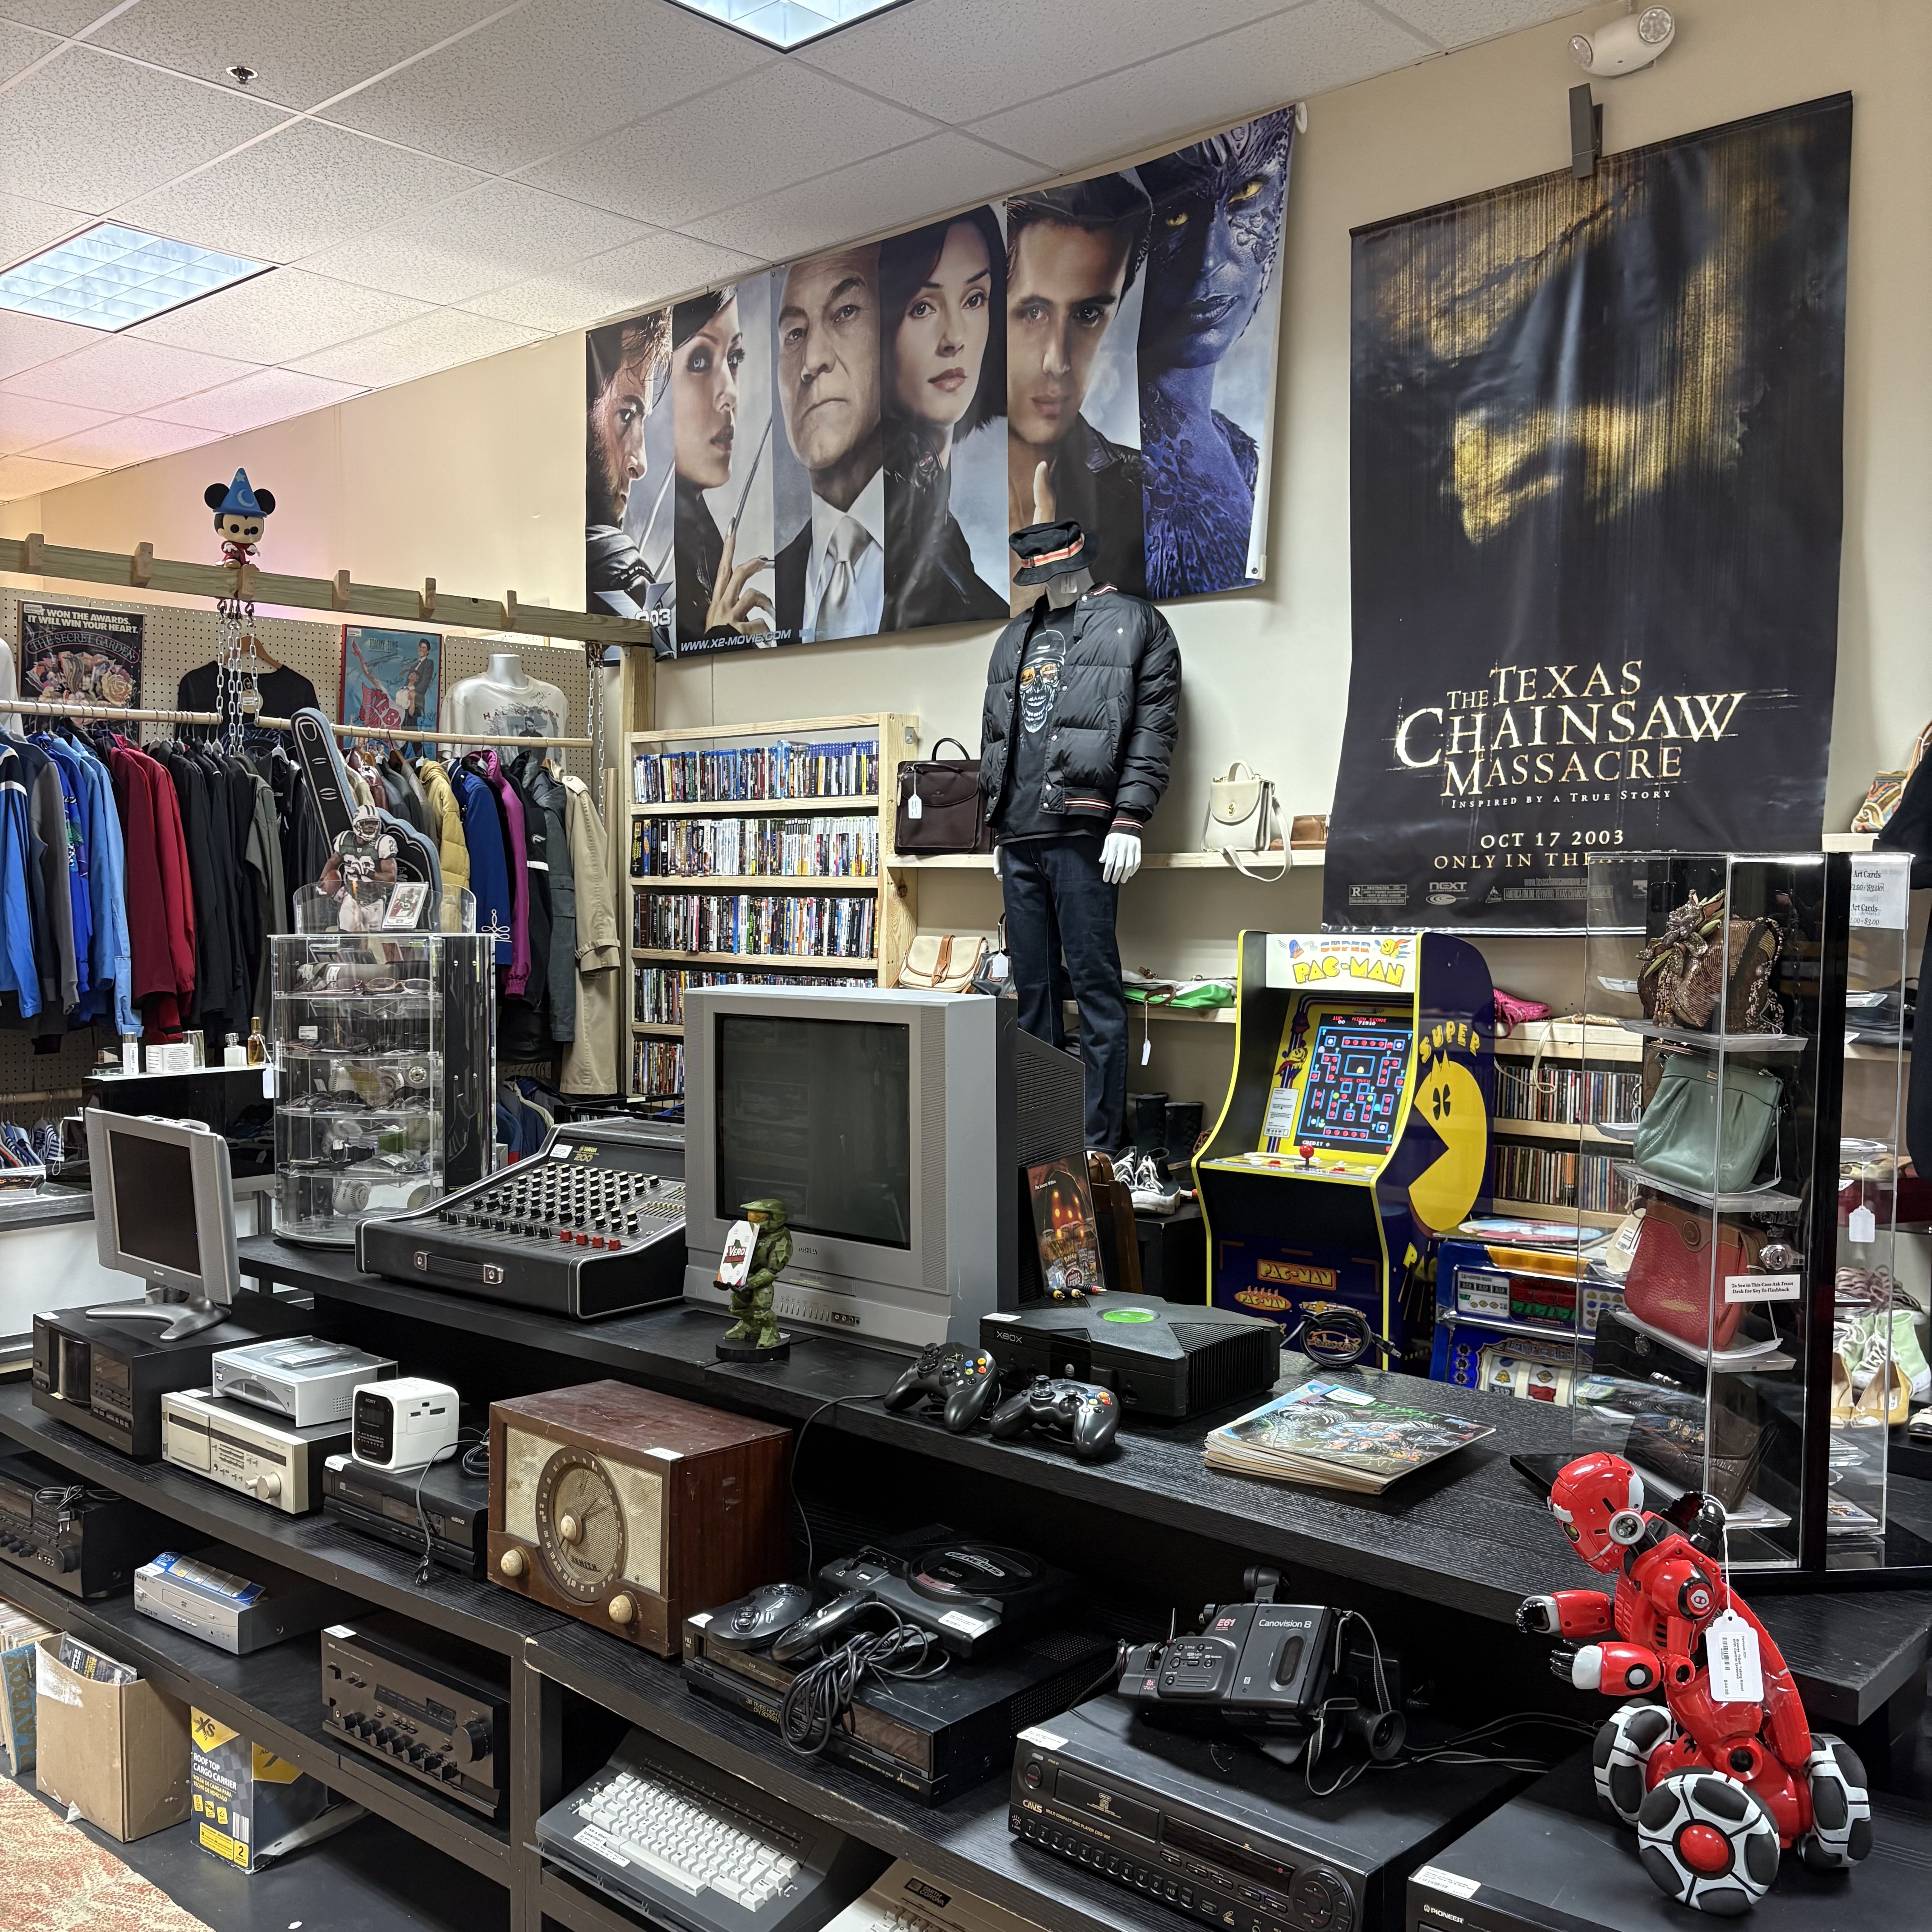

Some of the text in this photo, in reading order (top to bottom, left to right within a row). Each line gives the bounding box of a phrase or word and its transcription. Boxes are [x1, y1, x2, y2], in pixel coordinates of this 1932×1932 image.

[38, 616, 61, 626] WILL
[61, 619, 81, 628] WIN
[82, 621, 108, 630] YOUR
[108, 624, 138, 634] HEART.
[46, 609, 131, 625] WON THE AWARDS.
[30, 633, 136, 661] THE SECRET GARDEN
[369, 638, 399, 652] TOMMY TUNE
[1447, 661, 1642, 711] THE TEXAS
[483, 710, 507, 720] HAL
[1395, 692, 1748, 768] CHAINSAW
[1440, 746, 1683, 797] MASSACRE
[1451, 797, 1517, 809] INSPIRED
[1526, 795, 1543, 804] BY
[1570, 792, 1610, 802] TRUE
[1620, 790, 1670, 800] STORY
[1481, 830, 1623, 848] OCT 17 2003
[1434, 853, 1532, 869] ONLY IN
[1863, 870, 1881, 878] Cards
[1351, 887, 1361, 897] R
[1861, 904, 1878, 912] Cards
[1321, 941, 1371, 952] SUPER
[1293, 956, 1405, 987] PAC-MAN
[1419, 1021, 1480, 1064] SUPER
[574, 1153, 593, 1162] 200
[729, 1246, 745, 1257] VERO
[799, 1247, 818, 1255] TOSHIBA
[1260, 1263, 1333, 1287] PAC-MAN
[1239, 1293, 1287, 1310] PAC-MAN
[996, 1330, 1022, 1343] XBOX
[571, 1556, 597, 1571] ZENITH
[1259, 1619, 1312, 1628] Canovision 8
[761, 1710, 779, 1723] SCREEN
[195, 1717, 216, 1738] XS
[193, 1753, 221, 1771] ROOF TOP
[193, 1763, 237, 1790] CARGO CARRIER
[193, 1774, 204, 1784] BOLSA
[209, 1781, 221, 1793] CARGA
[222, 1788, 232, 1798] PARA
[193, 1781, 205, 1792] TECHO
[1022, 1799, 1043, 1813] CAVS
[1056, 1812, 1072, 1823] COMPACT
[1072, 1819, 1081, 1827] DISC
[1081, 1822, 1094, 1832] PLAYER
[239, 1846, 244, 1857] 2
[920, 1890, 944, 1905] CORONA
[923, 1886, 941, 1898] SMITH
[1431, 1907, 1464, 1924] PIONEER
